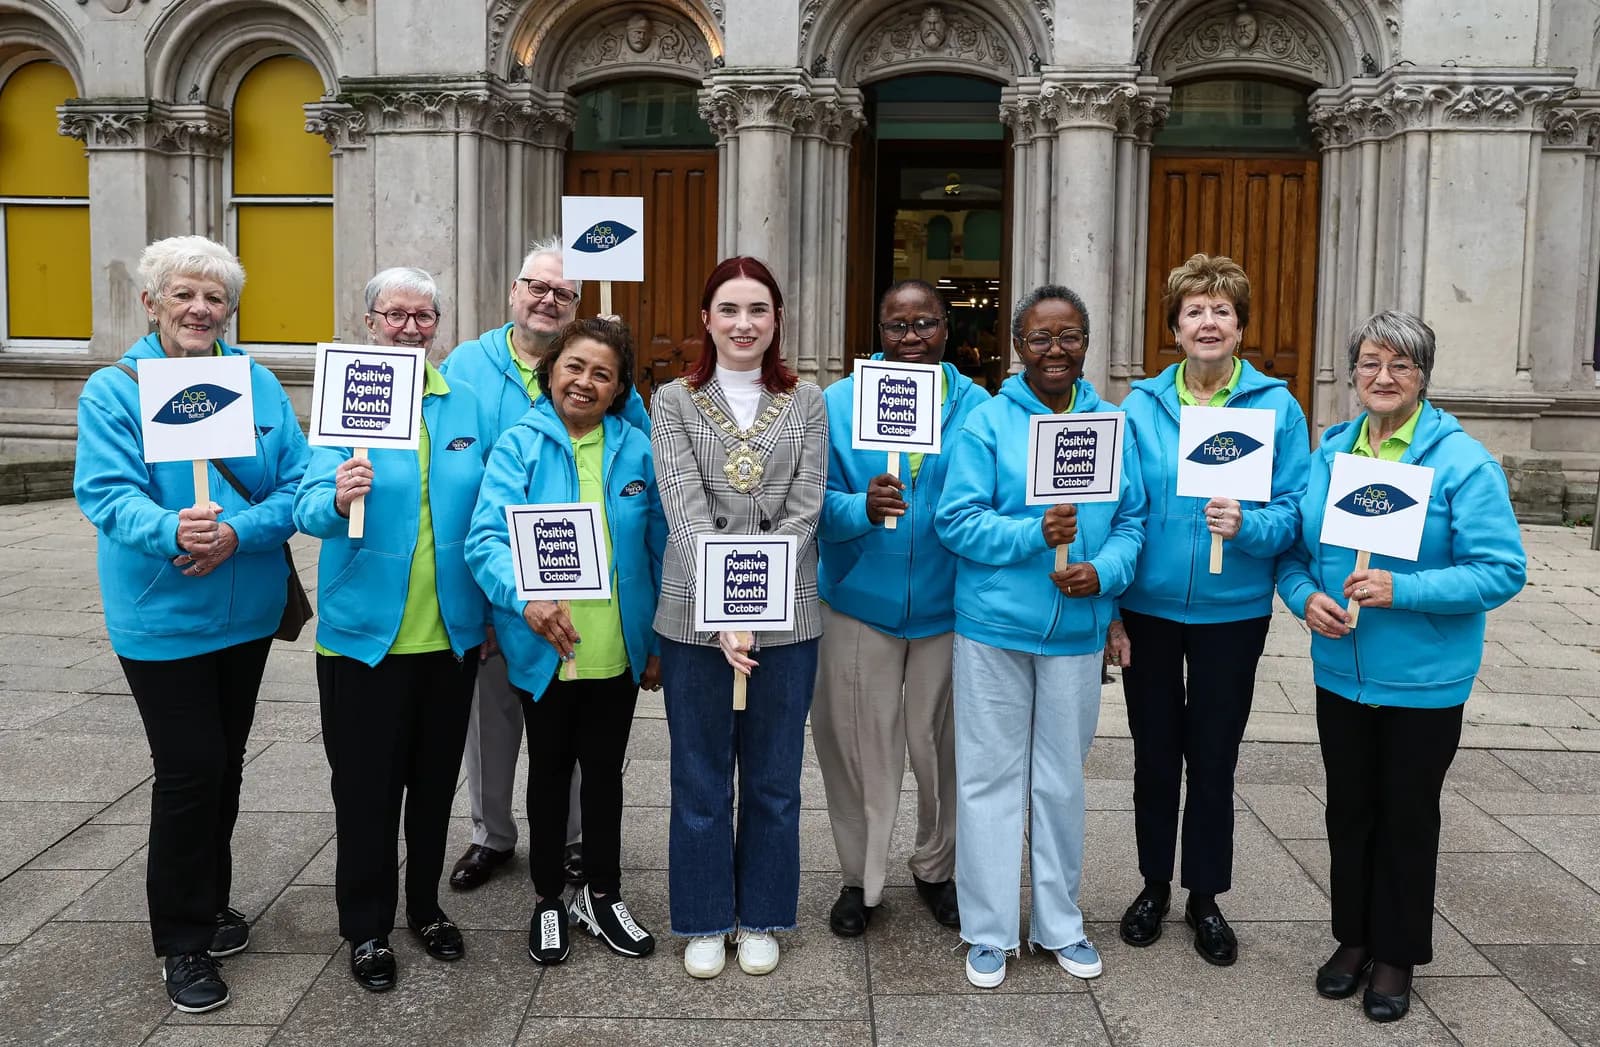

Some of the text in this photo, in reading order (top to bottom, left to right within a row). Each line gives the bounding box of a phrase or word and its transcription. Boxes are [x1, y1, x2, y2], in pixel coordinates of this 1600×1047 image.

[593, 225, 612, 236] Age
[586, 232, 619, 245] Friendly
[349, 368, 392, 382] Positive
[347, 382, 391, 398] Ageing
[880, 382, 916, 395] Positive
[181, 389, 206, 403] Age
[879, 394, 916, 409] Ageing
[172, 400, 218, 415] Friendly
[345, 397, 390, 413] Month
[879, 407, 915, 421] Month
[346, 417, 386, 429] October
[881, 425, 913, 436] October
[1057, 435, 1096, 447] Positive
[1212, 434, 1234, 448] Age
[1056, 447, 1095, 461] Ageing
[1203, 443, 1243, 459] Friendly
[1055, 460, 1093, 474] Month
[1057, 478, 1091, 488] October
[1365, 485, 1387, 500] Age
[1353, 493, 1394, 514] Friendly
[536, 526, 575, 538] Positive
[538, 539, 576, 554] Ageing
[539, 553, 578, 567] Month
[726, 558, 767, 570] Positive
[543, 572, 578, 581] October
[726, 571, 767, 585] Ageing
[725, 585, 766, 599] Month
[728, 604, 764, 614] October
[543, 911, 557, 948] GABBANA
